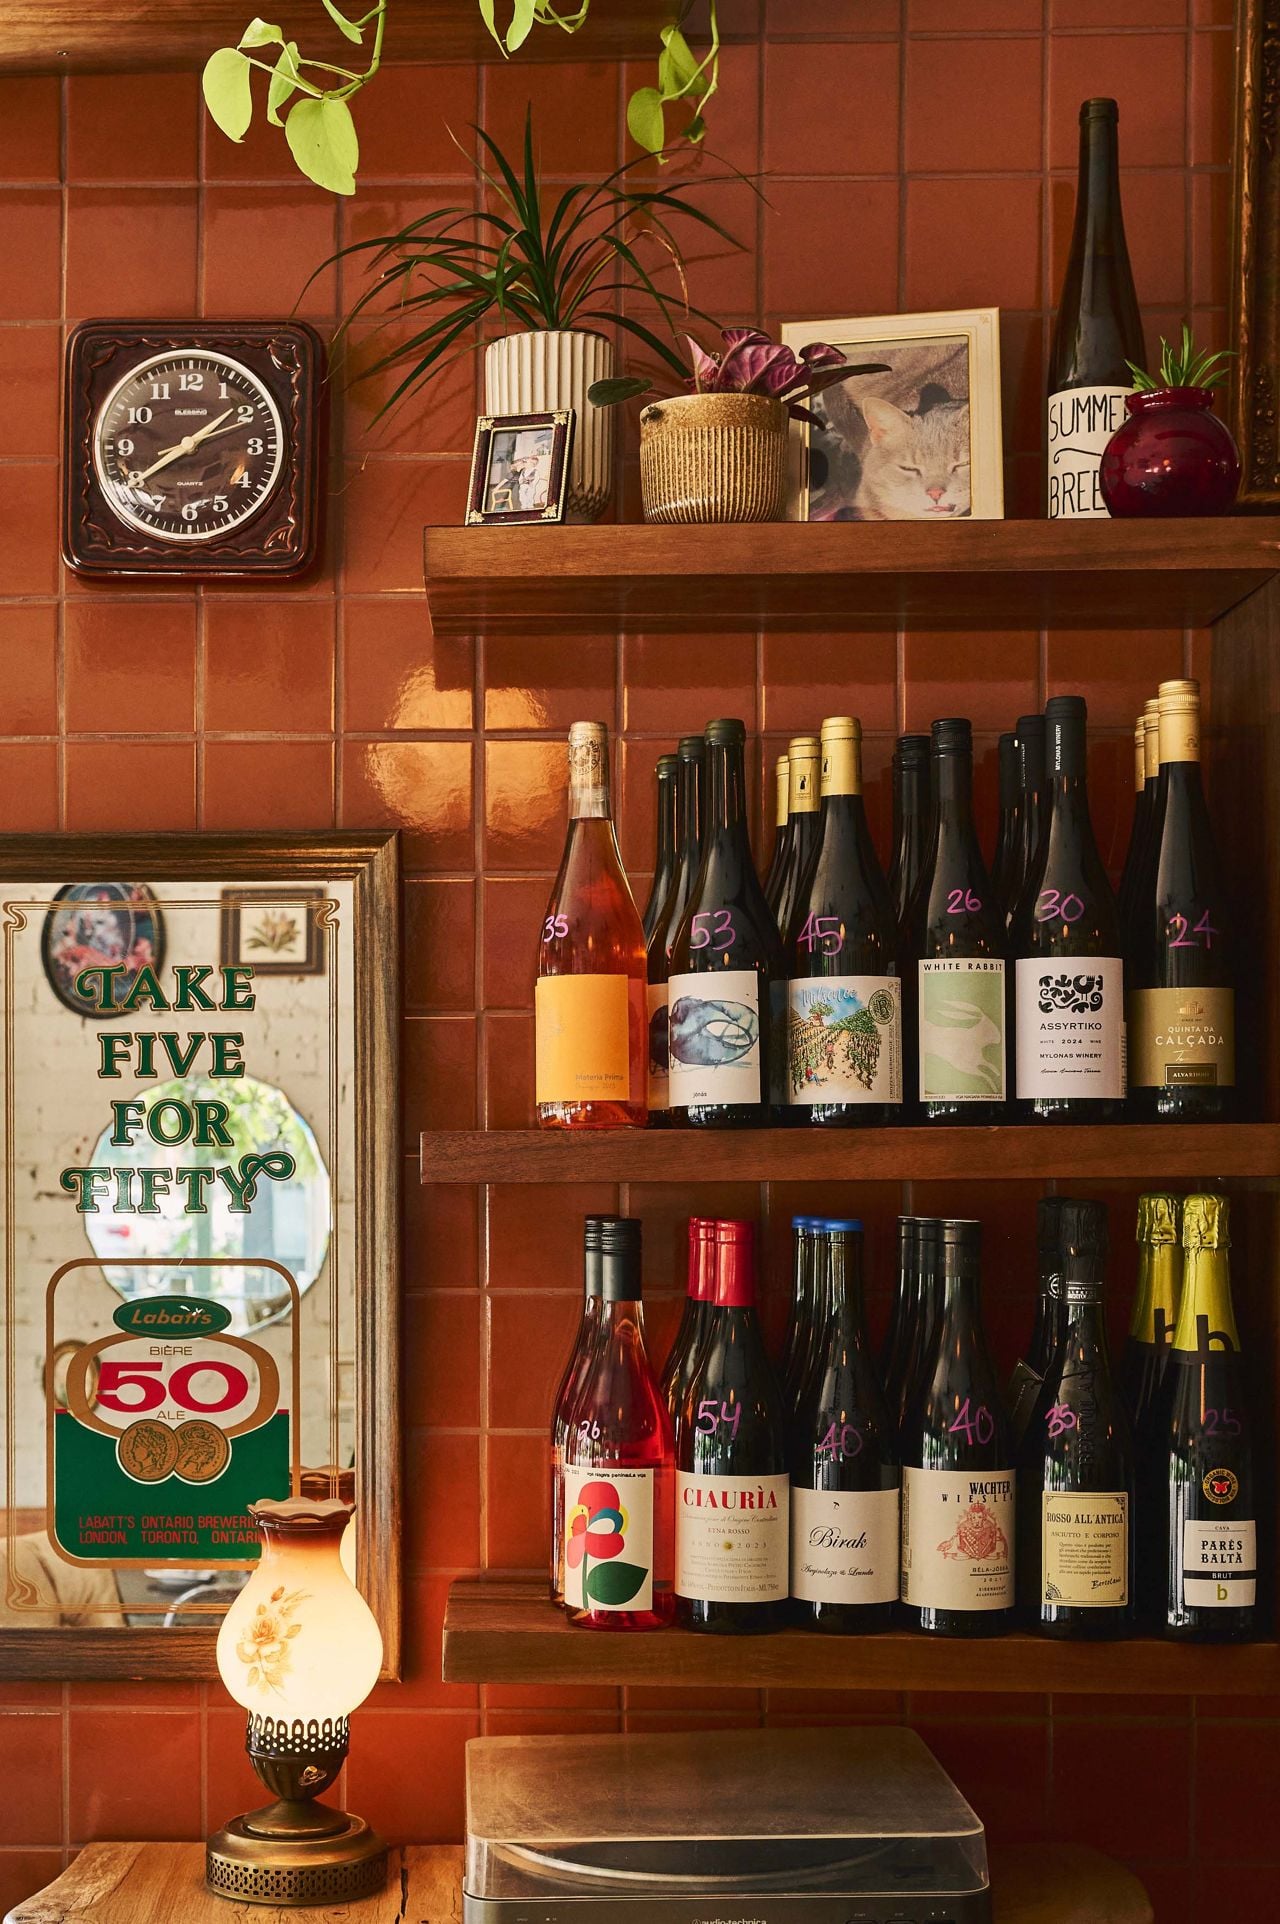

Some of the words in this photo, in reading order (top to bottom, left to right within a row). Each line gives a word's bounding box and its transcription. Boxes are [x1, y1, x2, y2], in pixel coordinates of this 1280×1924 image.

[150, 383, 171, 400] 11
[178, 374, 204, 391] 12
[218, 382, 229, 398] 1
[127, 406, 152, 424] 10
[237, 405, 254, 423] 2
[118, 438, 134, 456] 9
[246, 438, 264, 456] 3
[128, 470, 145, 488] 8
[234, 470, 252, 488] 4
[152, 494, 166, 512] 7
[182, 503, 198, 520] 6
[212, 495, 228, 512] 5
[946, 888, 982, 914] 26
[1036, 889, 1085, 922] 30
[543, 914, 569, 943] 35
[689, 910, 736, 951] 53
[797, 911, 843, 956] 45
[1168, 910, 1218, 950] 24
[75, 963, 256, 1012] TAKE
[1040, 1022, 1102, 1030] ASSYRTIKO
[1155, 1036, 1224, 1047] CALÇADA
[98, 1032, 246, 1078] FIVE
[110, 1098, 234, 1147] FOR
[60, 1151, 296, 1214] FIFTY
[131, 1307, 212, 1326] Labatt's
[149, 1345, 192, 1356] BIÈRE
[96, 1361, 248, 1413] 50
[156, 1410, 185, 1420] ALE
[696, 1400, 741, 1440] 54
[948, 1398, 994, 1446] 40
[1044, 1402, 1078, 1438] 35
[1204, 1408, 1241, 1436] 25
[577, 1420, 601, 1442] 26
[815, 1422, 863, 1461] 40
[970, 1481, 1011, 1495] WACHTER
[683, 1486, 778, 1509] CIAURÌA
[80, 1515, 136, 1529] LABATT'S
[141, 1515, 193, 1529] ONTARIO
[1046, 1512, 1071, 1523] ROSSO
[808, 1526, 867, 1549] Birak
[1201, 1552, 1242, 1563] BALTÀ
[1217, 1584, 1228, 1600] b
